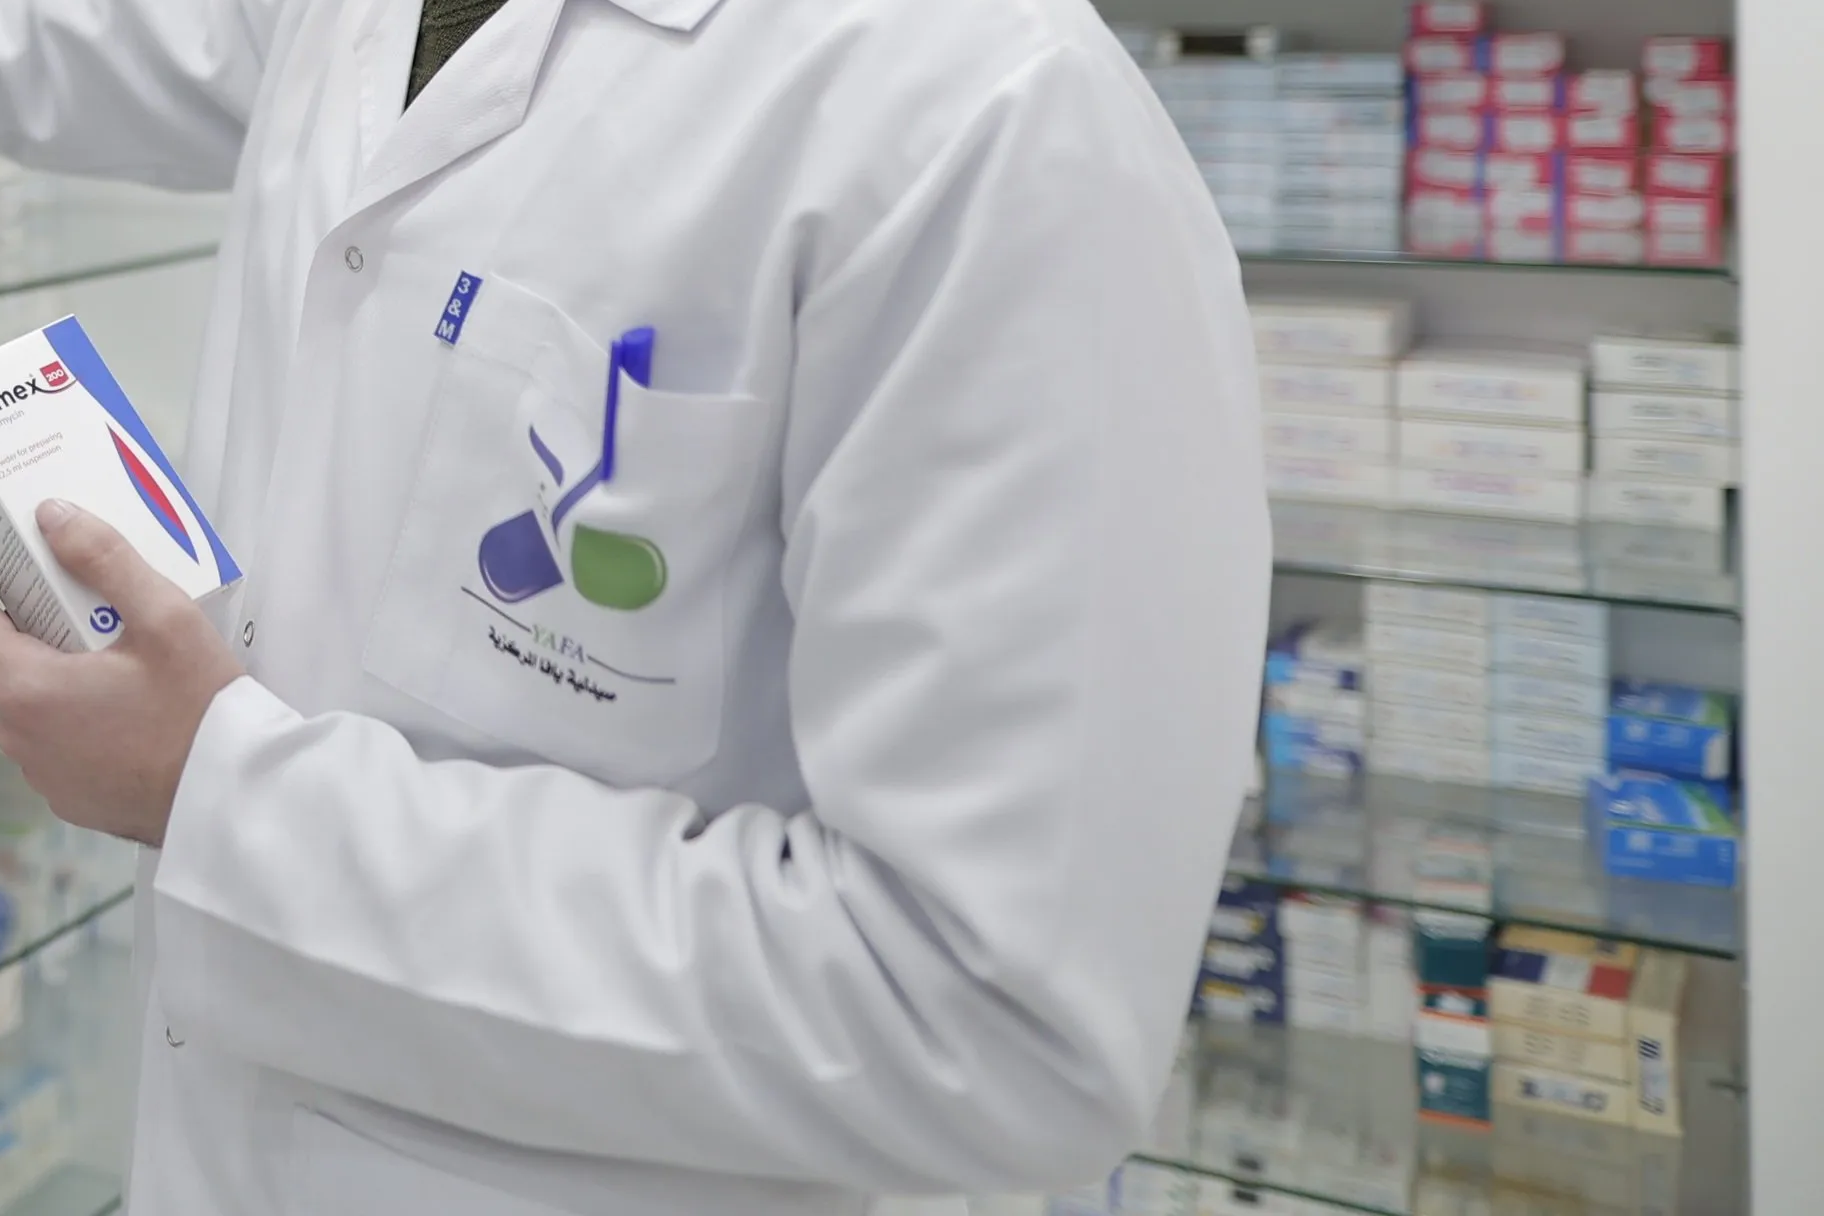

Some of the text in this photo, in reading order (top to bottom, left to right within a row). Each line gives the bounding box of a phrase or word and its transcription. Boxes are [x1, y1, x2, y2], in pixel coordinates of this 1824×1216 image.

[45, 368, 65, 383] 200
[12, 460, 23, 474] ml
[23, 443, 63, 469] suspension
[17, 444, 29, 458] for
[29, 429, 64, 455] preparing
[533, 624, 585, 664] YAFA
